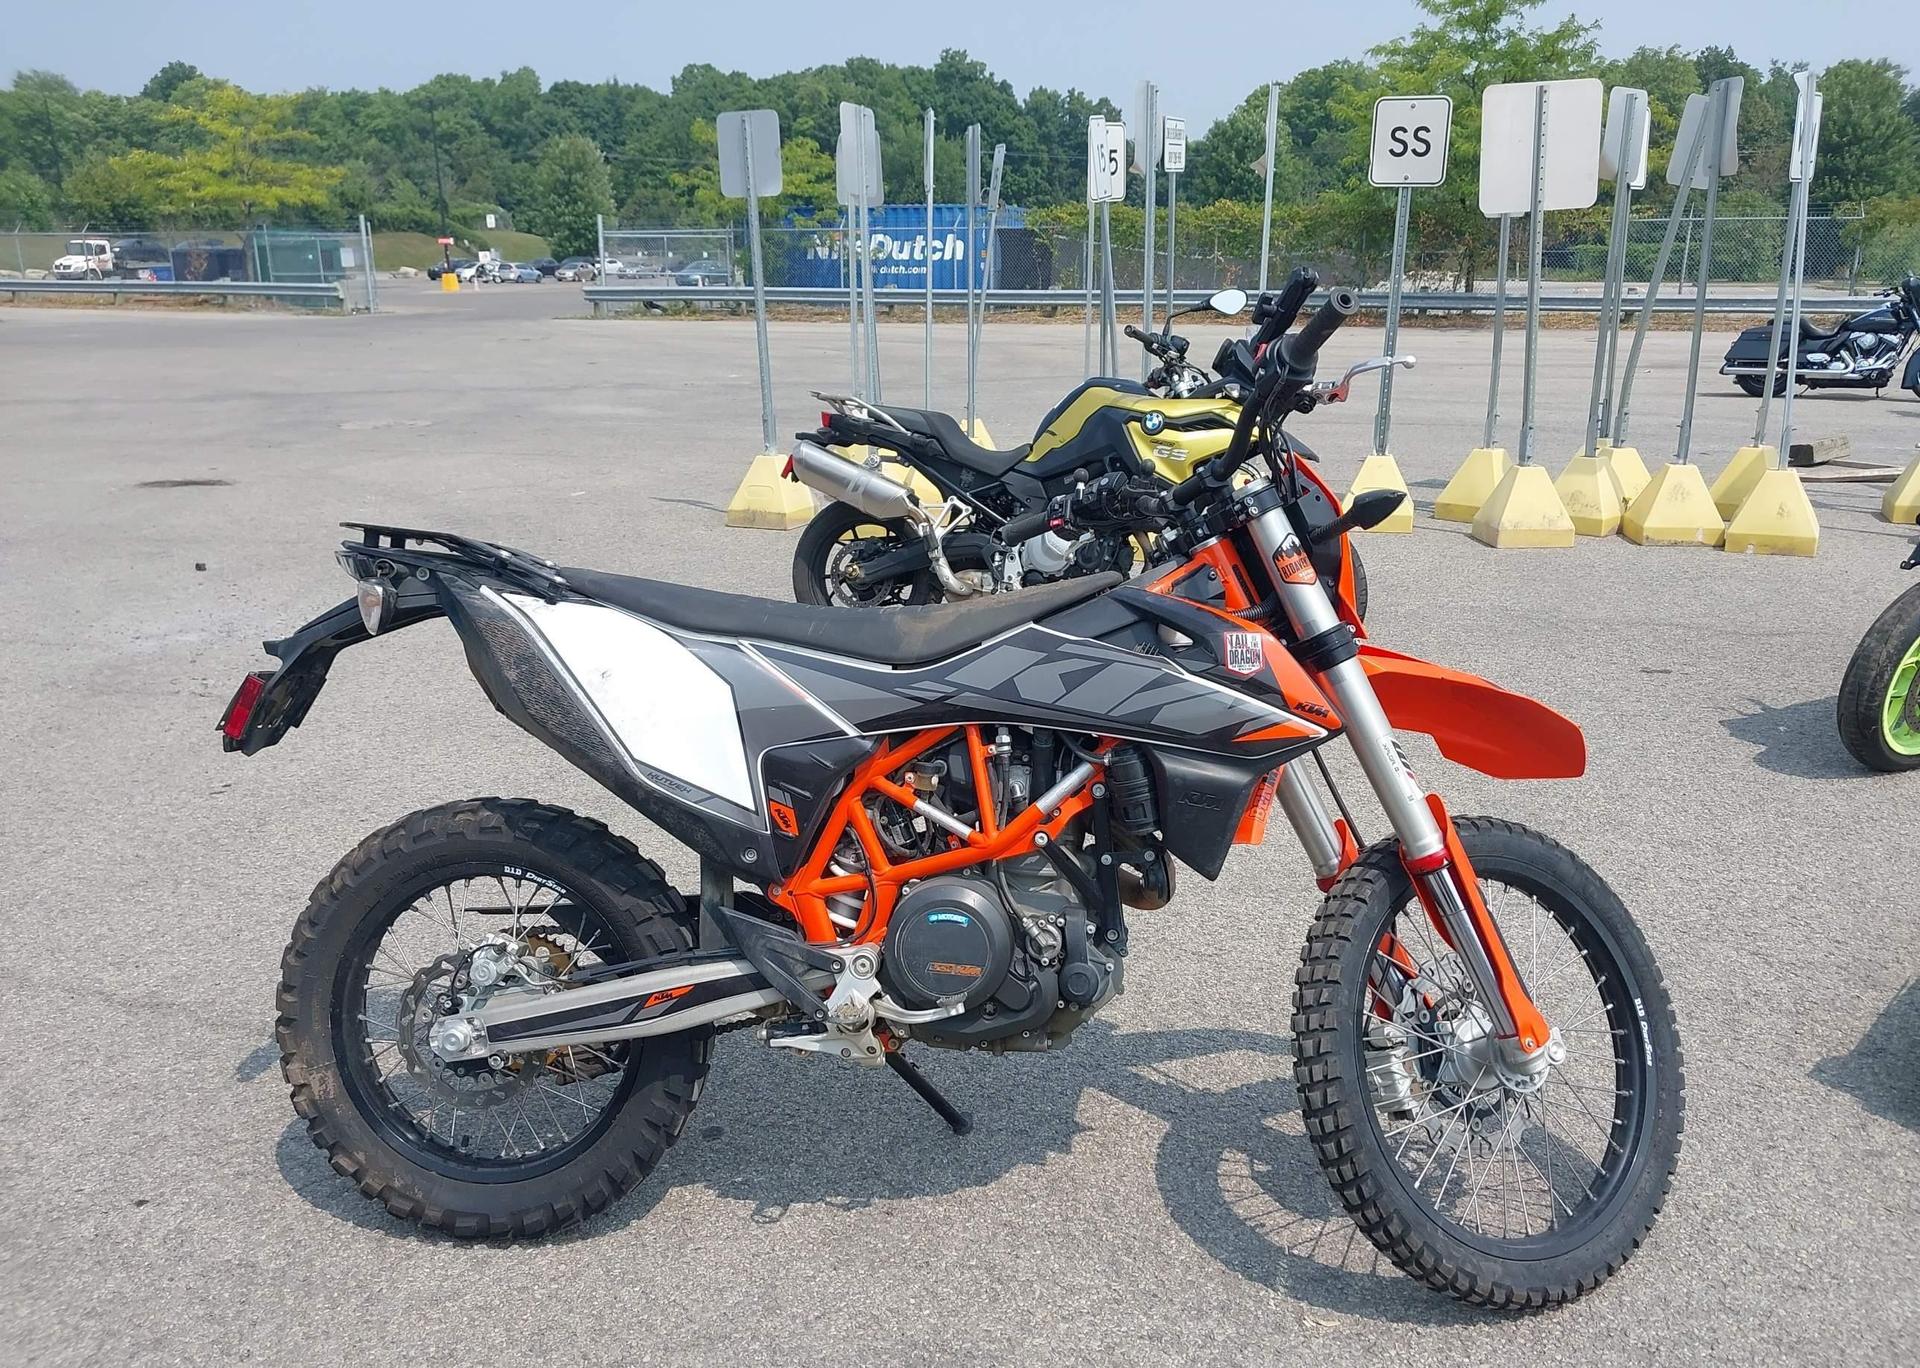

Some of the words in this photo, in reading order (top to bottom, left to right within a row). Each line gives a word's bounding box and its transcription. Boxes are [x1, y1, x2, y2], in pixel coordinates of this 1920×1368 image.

[1389, 126, 1431, 157] SS
[1229, 649, 1261, 665] DRAGON
[1294, 702, 1330, 718] KTM
[775, 808, 792, 829] KTM
[653, 991, 674, 1001] KTM
